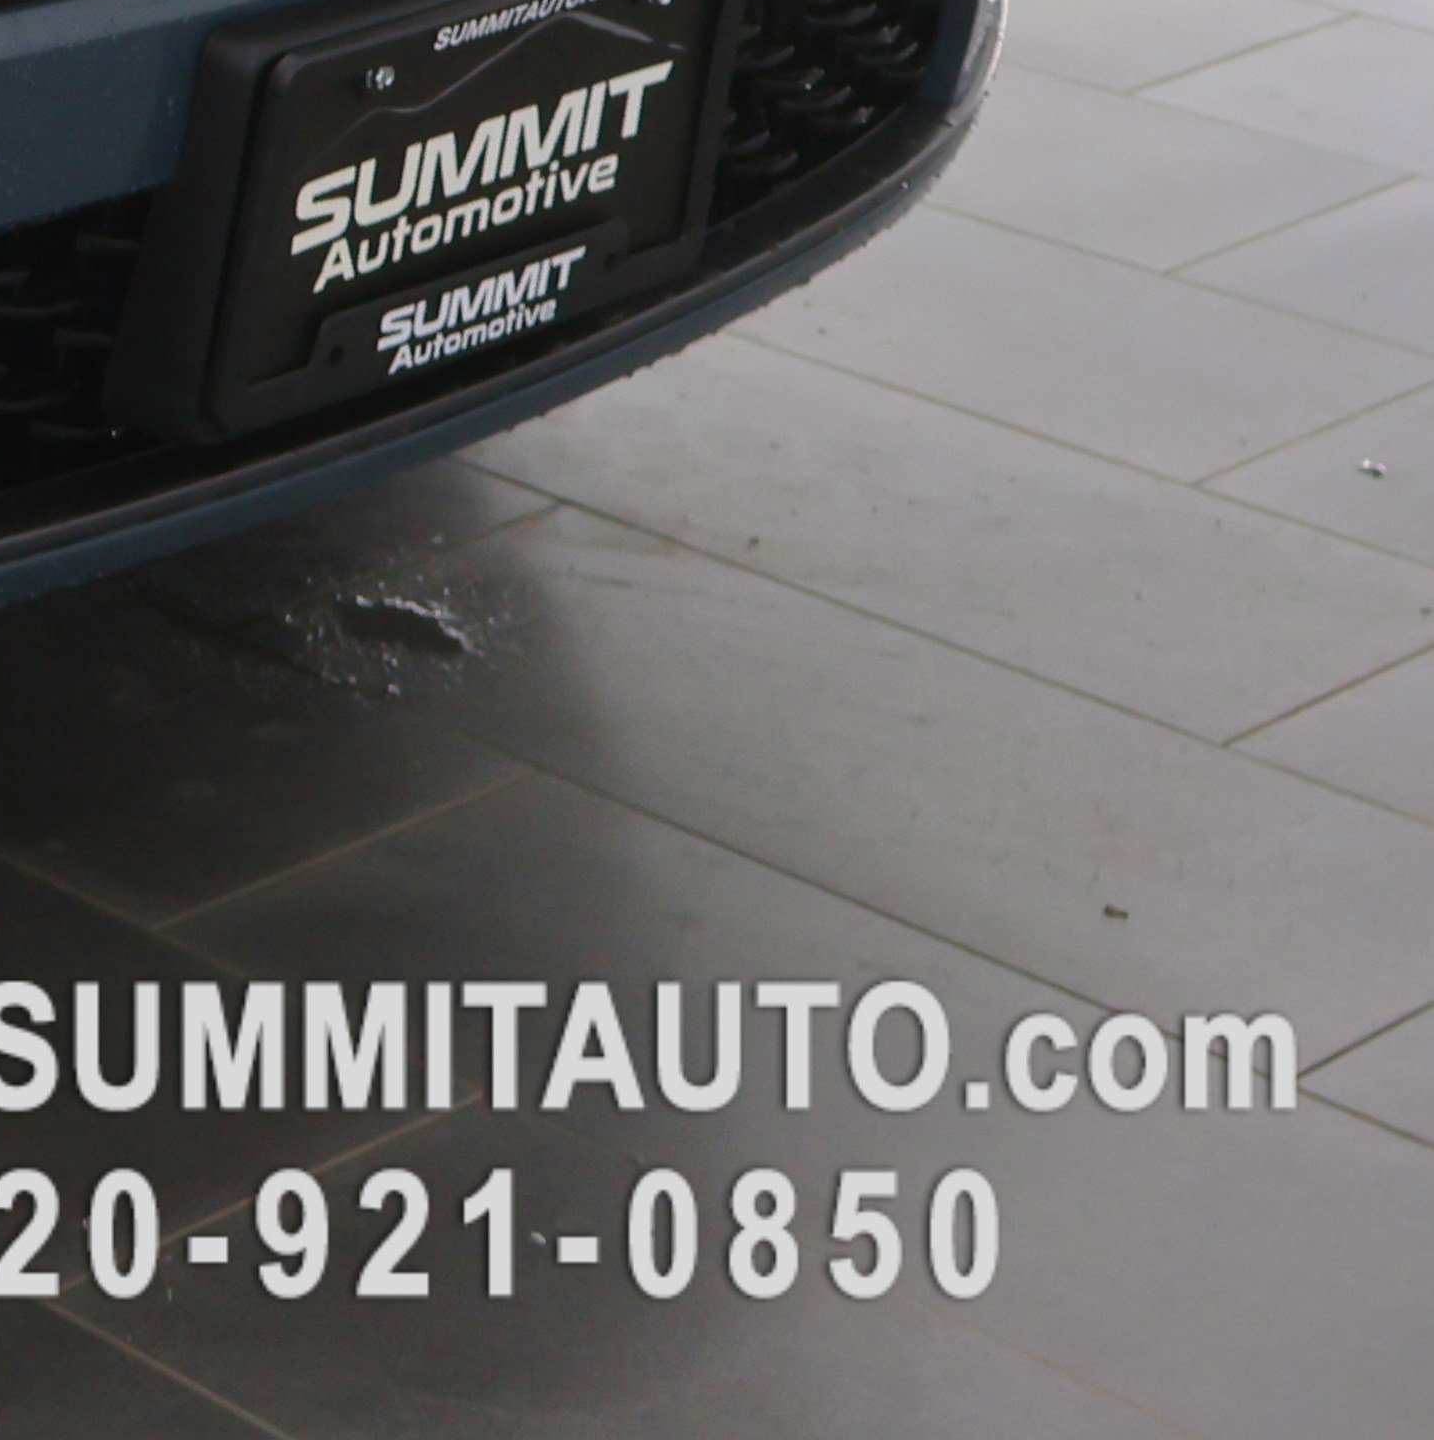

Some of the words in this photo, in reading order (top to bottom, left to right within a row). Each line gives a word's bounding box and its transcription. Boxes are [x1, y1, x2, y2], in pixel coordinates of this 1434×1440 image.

[290, 60, 675, 255] SUMMIT
[312, 153, 619, 294] Automotive
[376, 245, 587, 352] SUMMIT
[387, 297, 558, 375] Automotive
